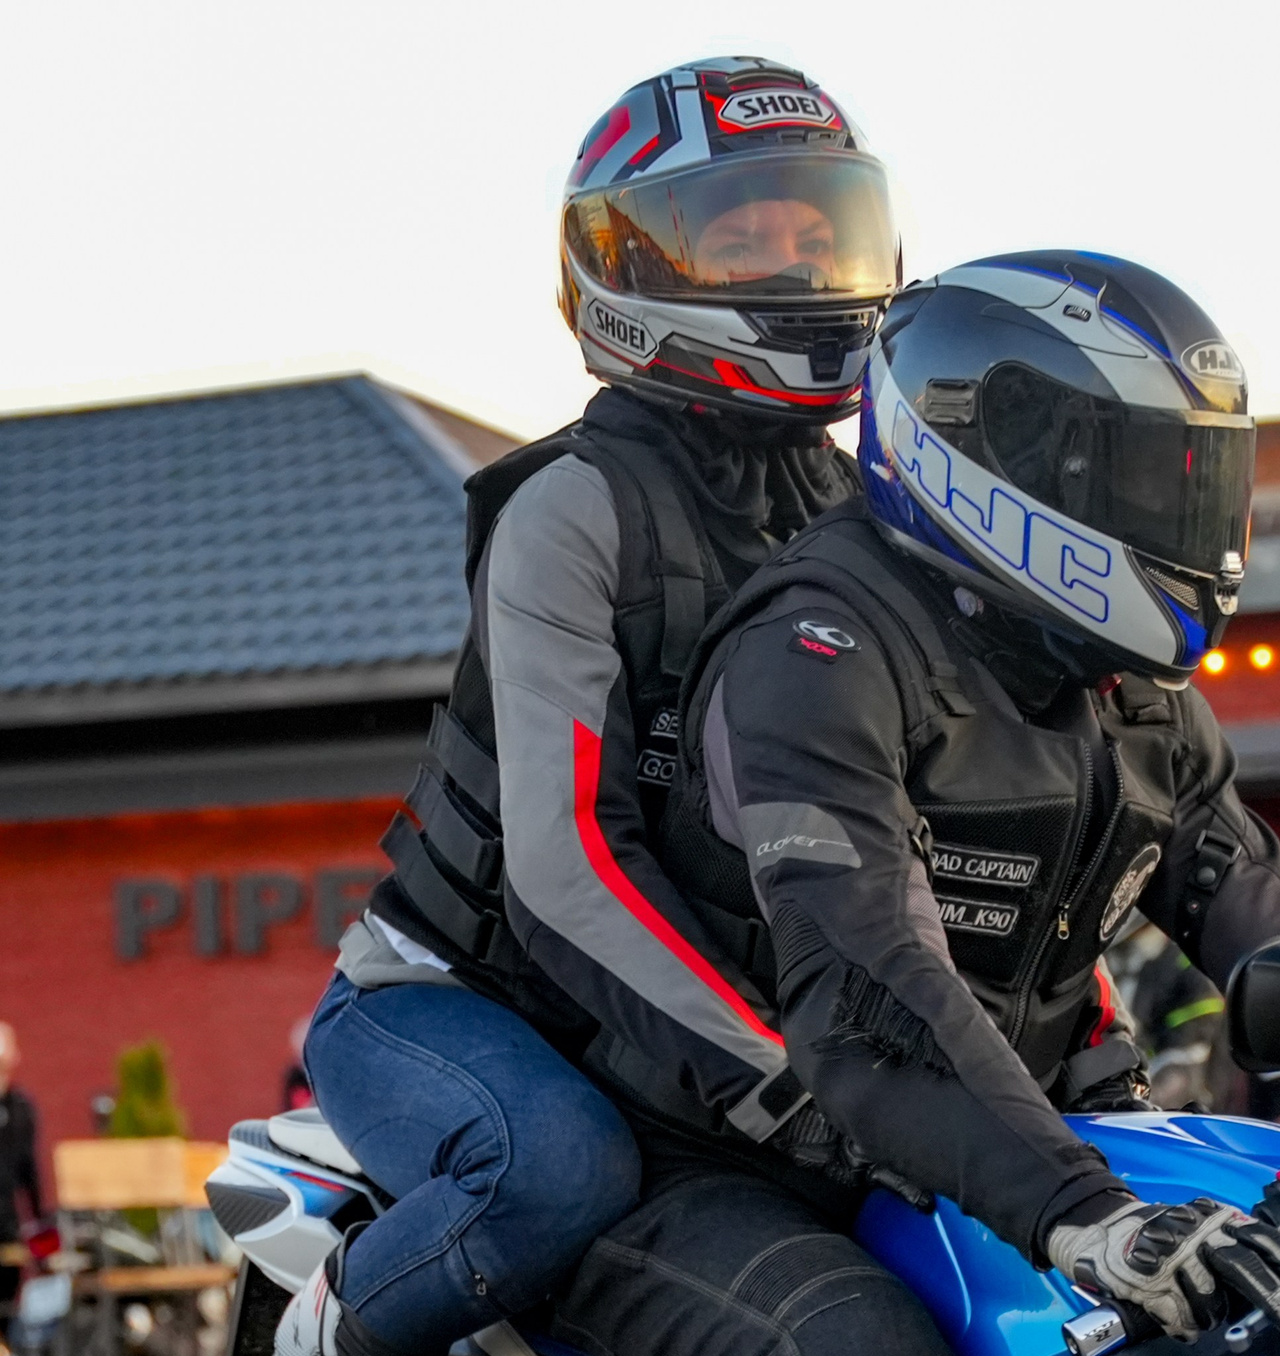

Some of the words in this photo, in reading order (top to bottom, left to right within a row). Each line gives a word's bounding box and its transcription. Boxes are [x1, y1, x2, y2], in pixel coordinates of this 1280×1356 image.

[737, 94, 824, 119] SHOEI
[595, 305, 646, 353] SHOEI
[892, 399, 1112, 624] HJC
